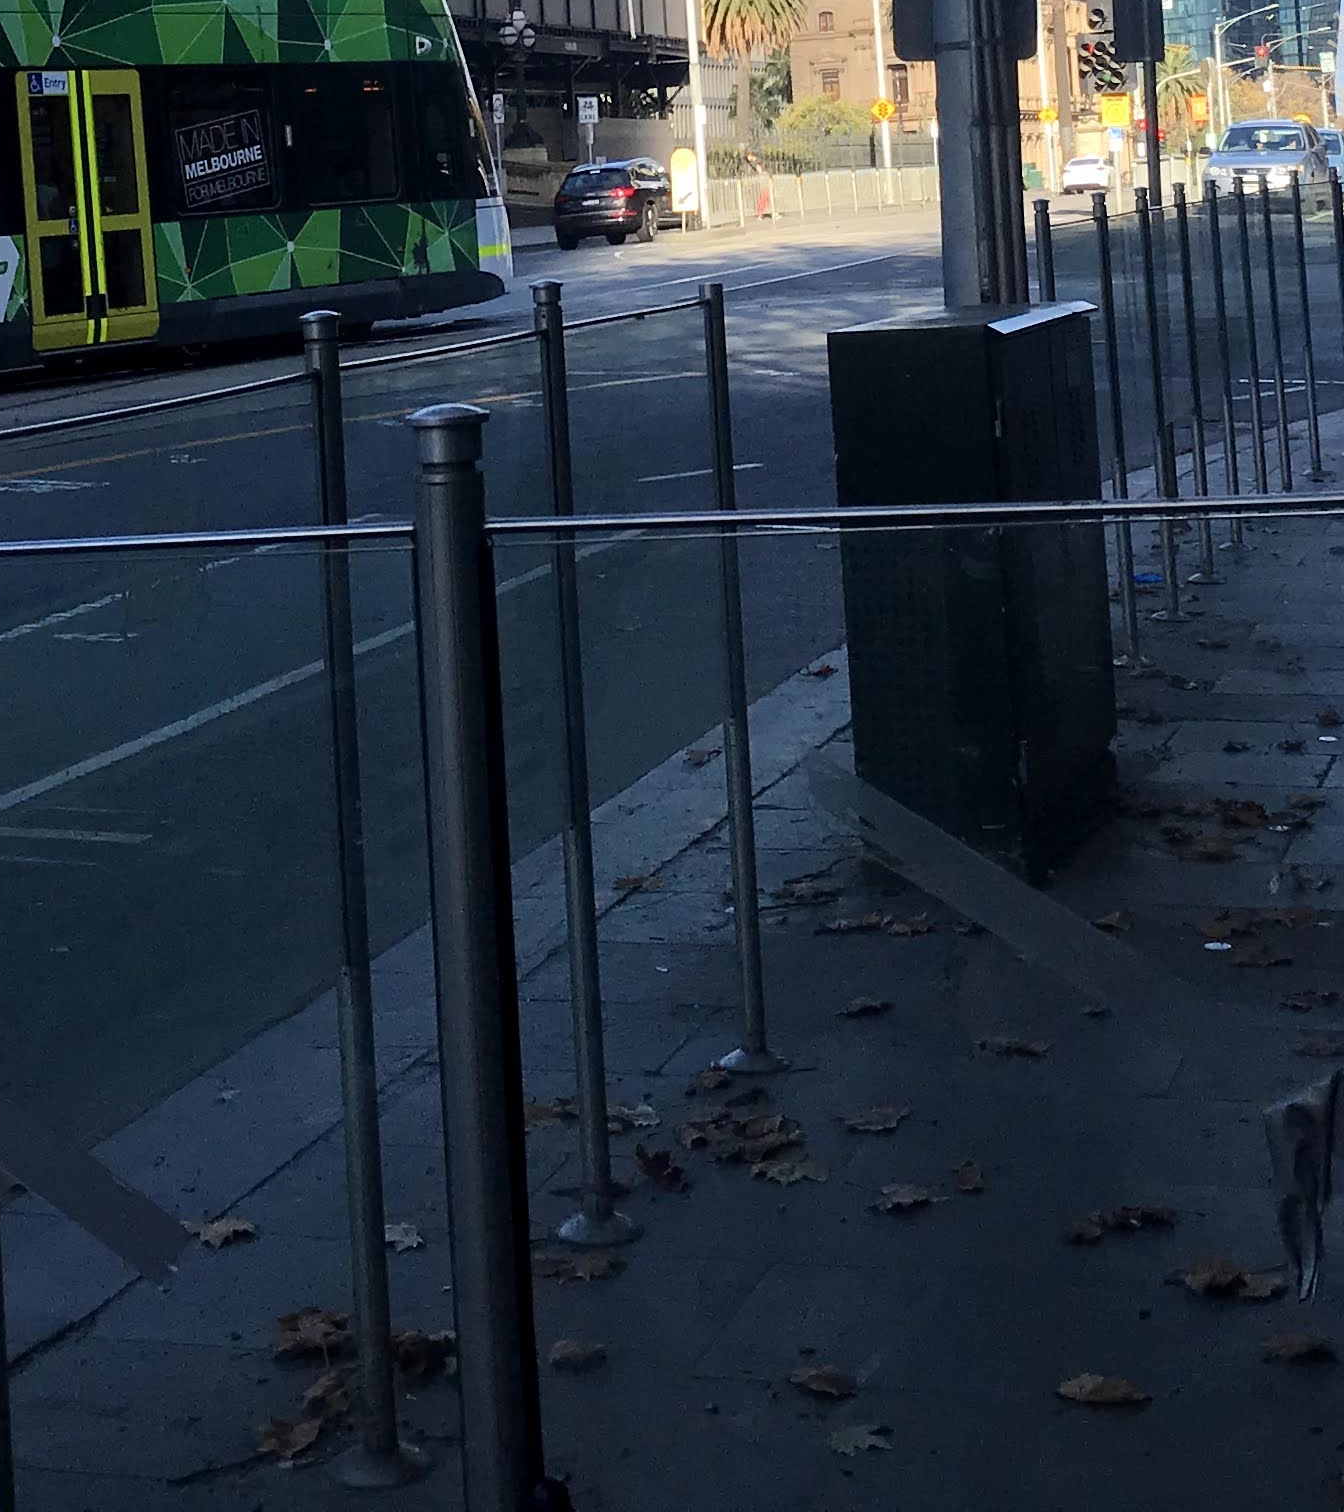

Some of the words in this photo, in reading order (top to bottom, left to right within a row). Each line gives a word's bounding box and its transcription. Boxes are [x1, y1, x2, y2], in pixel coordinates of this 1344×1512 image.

[44, 77, 66, 91] Entry
[179, 120, 238, 161] MADE
[240, 115, 260, 144] IN
[184, 144, 263, 180] MELBOURNE
[188, 183, 209, 202] FOR
[208, 167, 267, 197] MELBOURNE
